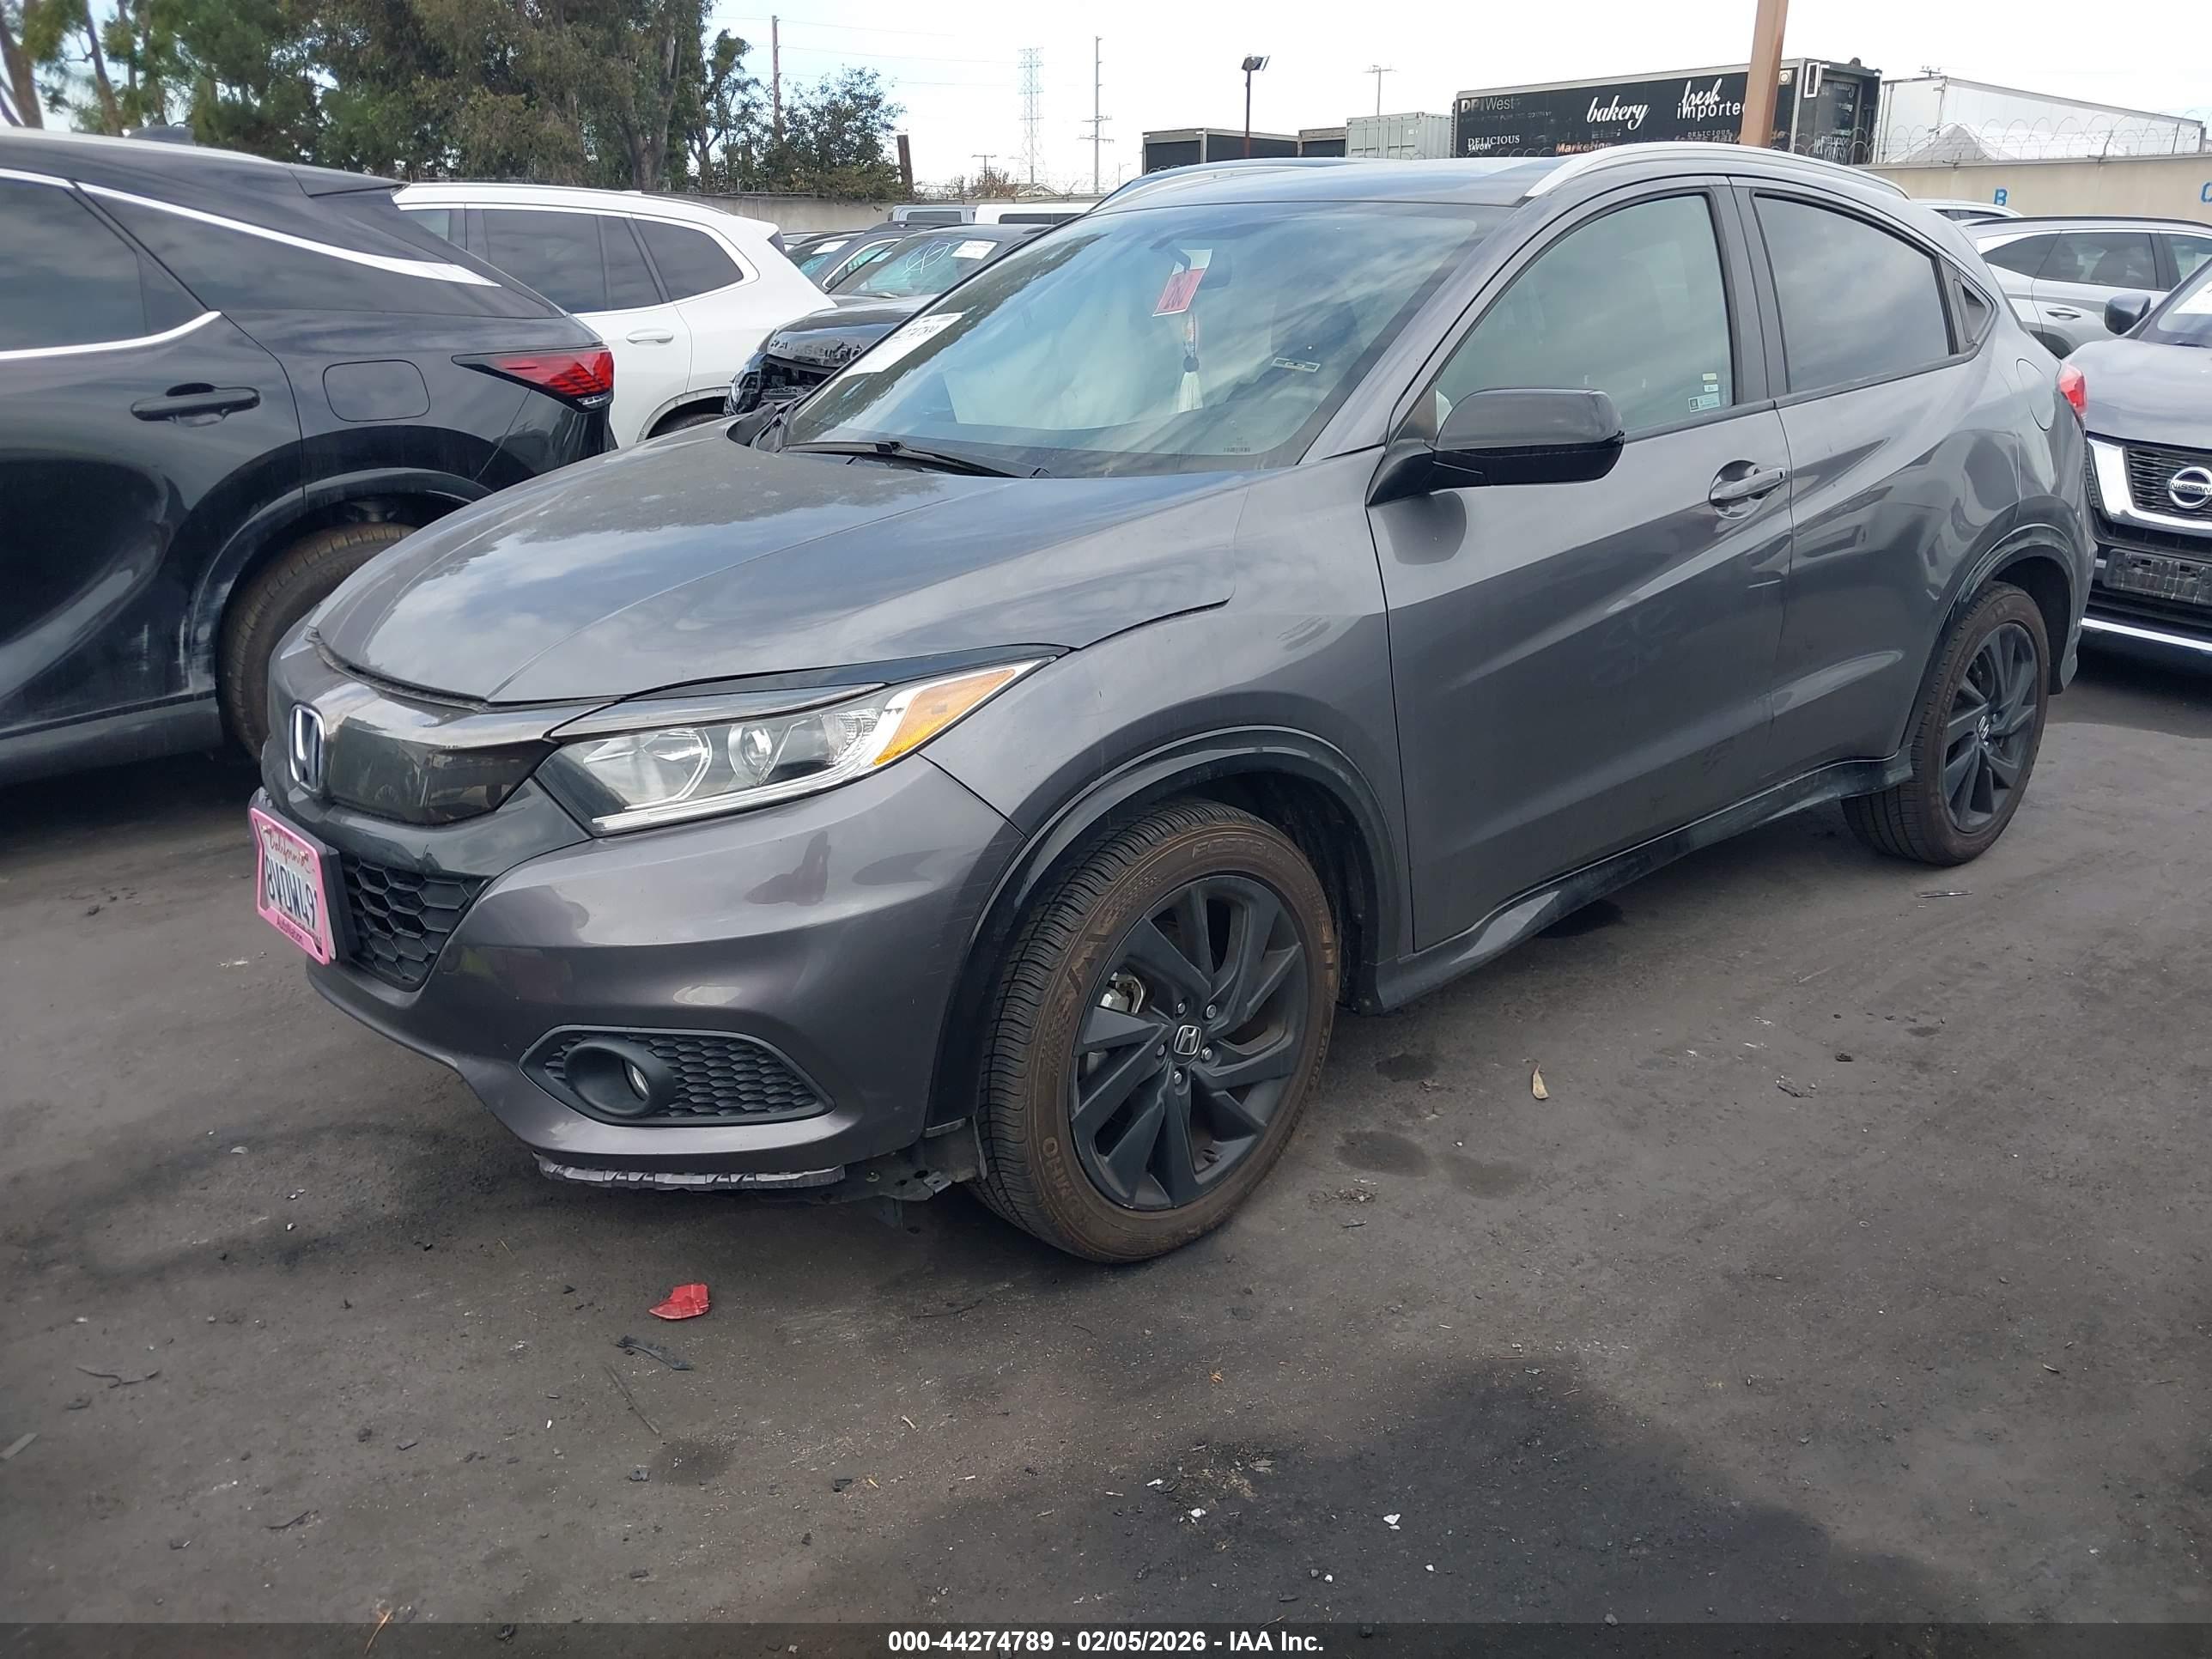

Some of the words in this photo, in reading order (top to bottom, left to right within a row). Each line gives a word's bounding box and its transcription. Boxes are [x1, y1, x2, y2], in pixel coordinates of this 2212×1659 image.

[1681, 78, 1723, 107] fresh
[1486, 96, 1516, 111] West
[1586, 94, 1650, 131] bakery
[1677, 100, 1746, 122] importe
[1468, 135, 1520, 147] DELICIOUS
[1993, 188, 2008, 206] B
[2171, 483, 2212, 494] NISSAN
